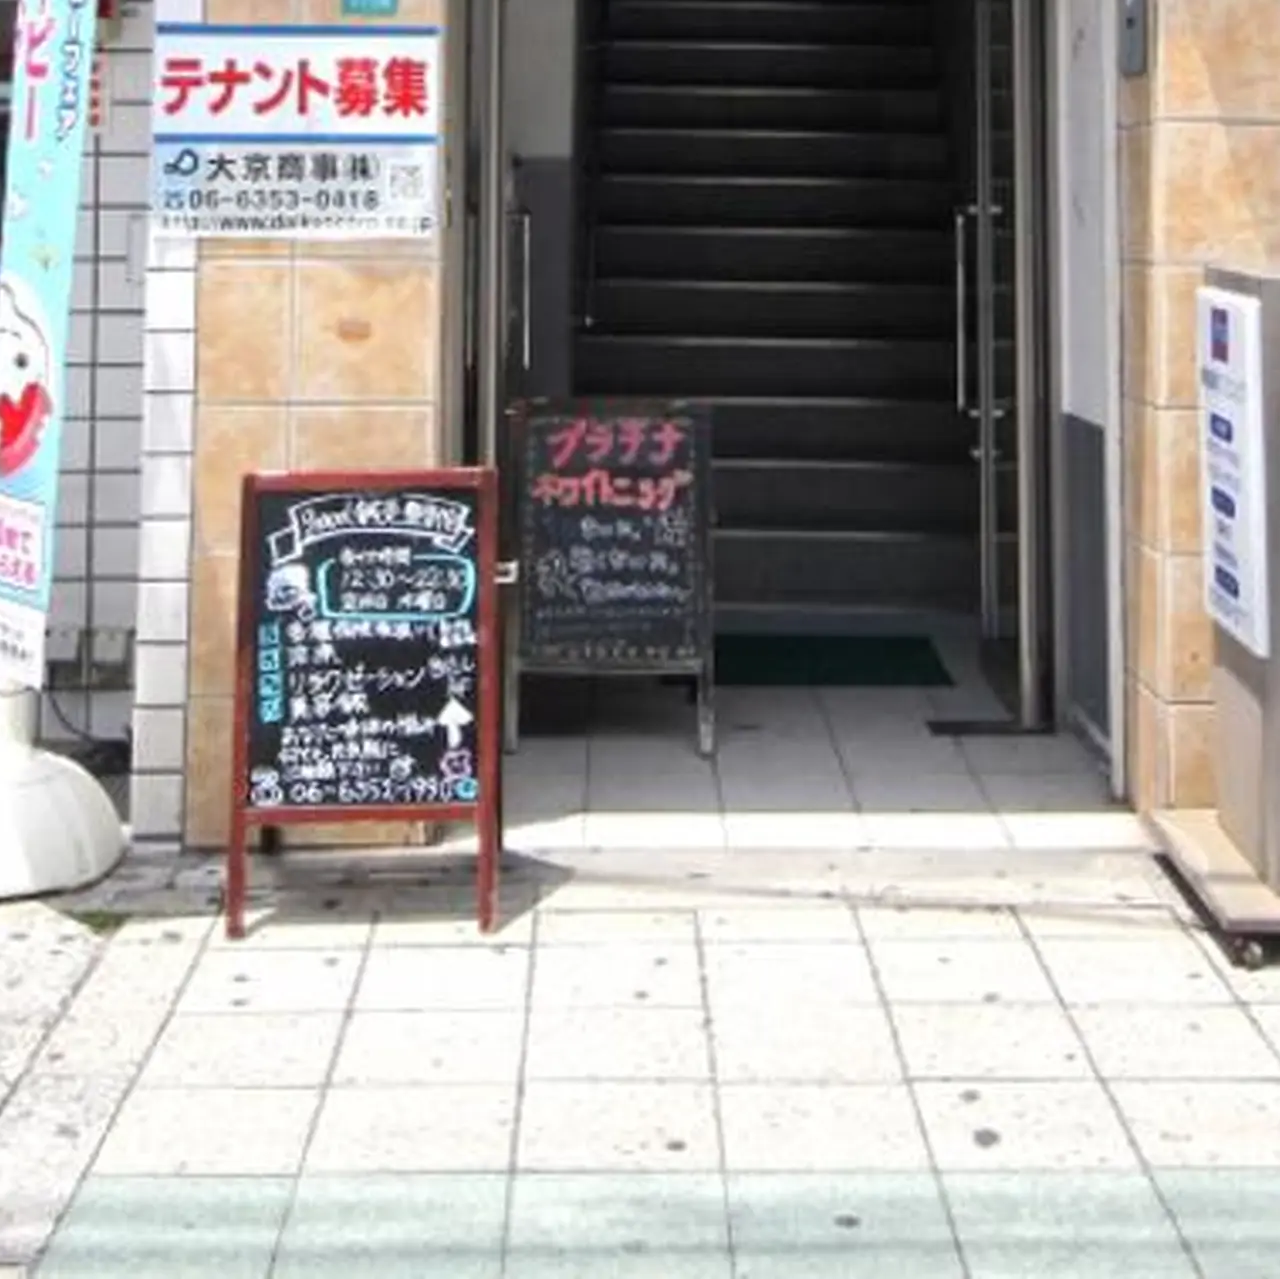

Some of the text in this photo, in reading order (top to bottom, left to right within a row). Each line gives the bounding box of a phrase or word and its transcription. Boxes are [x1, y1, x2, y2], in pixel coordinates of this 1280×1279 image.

[160, 55, 429, 118] テナント募集
[545, 417, 686, 467] プラチナ
